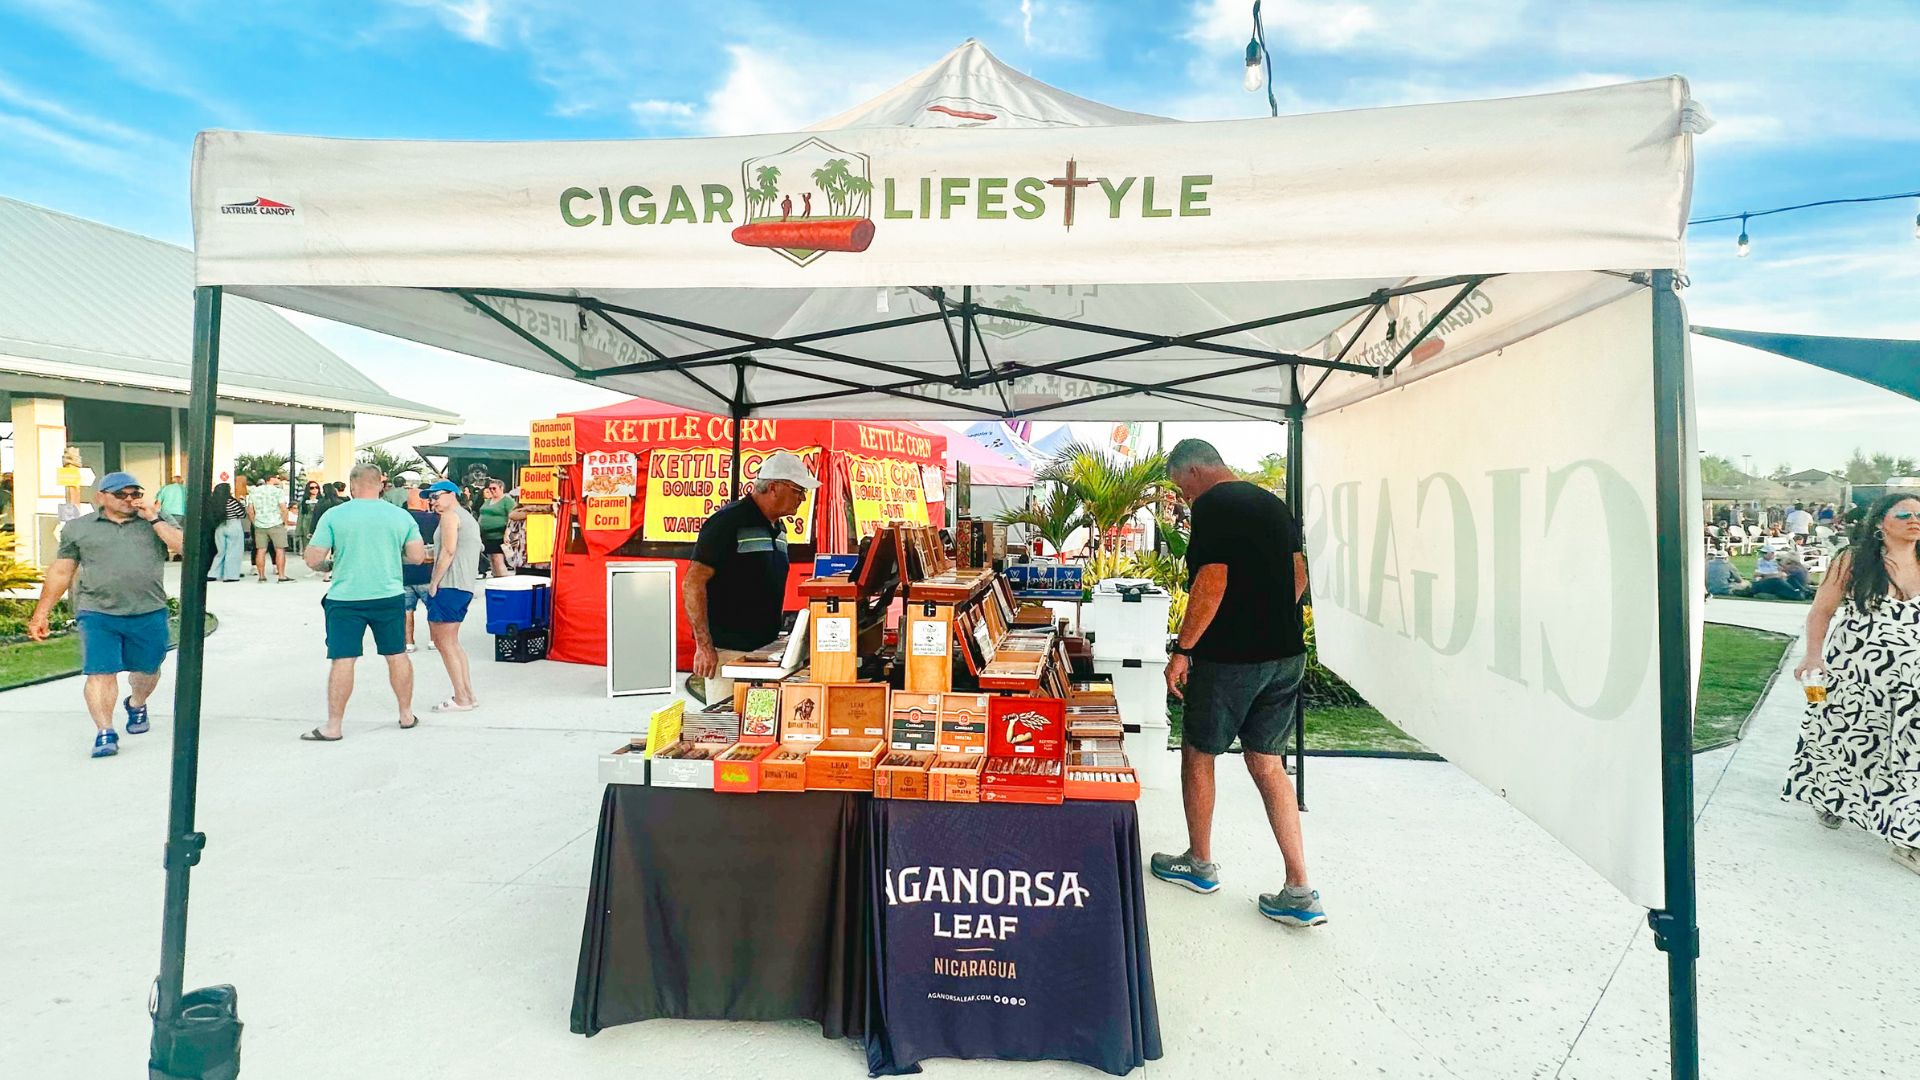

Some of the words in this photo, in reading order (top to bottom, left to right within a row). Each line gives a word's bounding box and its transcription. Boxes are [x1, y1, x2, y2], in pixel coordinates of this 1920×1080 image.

[221, 206, 258, 215] EXTREME
[260, 207, 296, 216] CANOPY
[560, 182, 734, 228] CIGAR
[532, 422, 572, 433] Cinnamon
[603, 416, 700, 443] KETTLE
[534, 436, 571, 448] Roasted
[858, 424, 906, 453] KETTLE
[906, 434, 932, 459] CORN
[533, 451, 573, 463] Almonds
[588, 453, 630, 465] PORK
[591, 465, 633, 476] RINDS
[650, 453, 732, 479] KETTLE
[524, 471, 551, 482] Boiled
[520, 488, 554, 499] Peanuts
[662, 480, 713, 497] BOILED
[718, 481, 729, 497] &
[588, 497, 627, 508] Caramel
[594, 514, 619, 526] Corn
[1170, 864, 1192, 873] HOKA
[933, 912, 1019, 940] LEAF
[934, 957, 1017, 980] NICARAGUA
[928, 991, 992, 1003] AGANORSALEAF.COM
